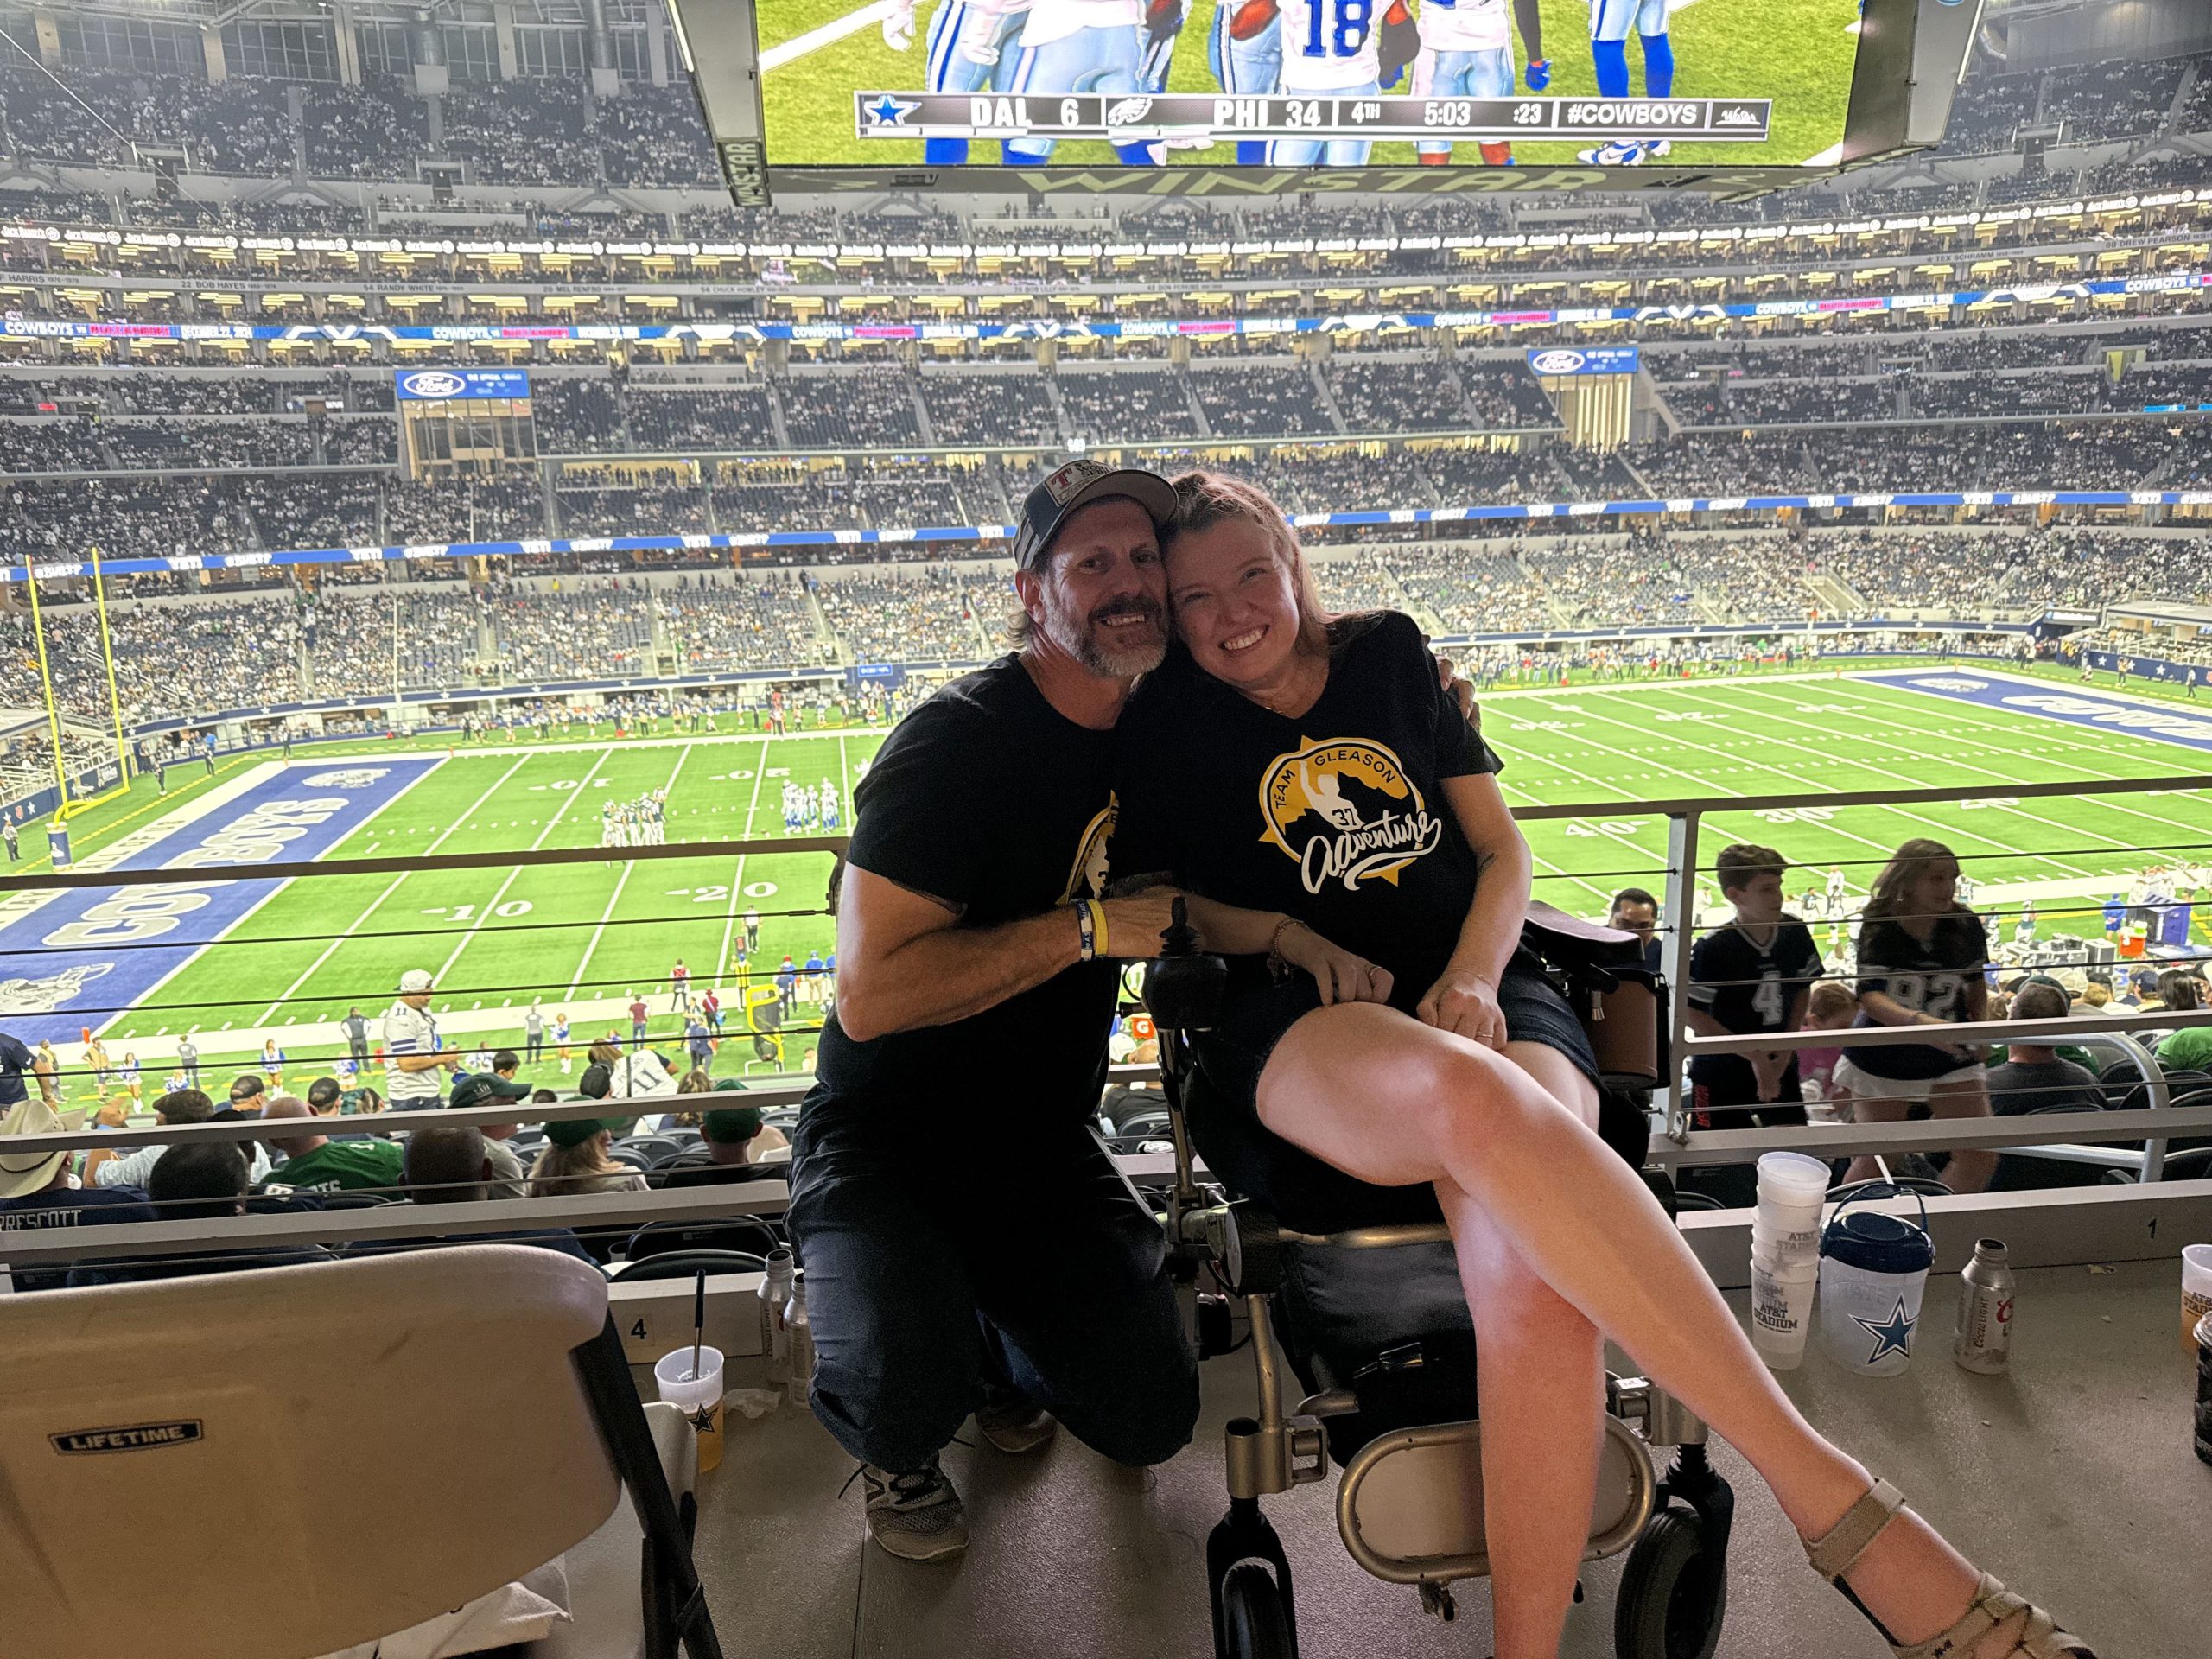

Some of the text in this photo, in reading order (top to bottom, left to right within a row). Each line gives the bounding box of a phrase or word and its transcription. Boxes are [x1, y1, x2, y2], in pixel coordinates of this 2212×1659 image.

[1302, 0, 1372, 57] 18
[970, 97, 1079, 127] DAL 6
[1214, 99, 1321, 129] PHI 34
[1351, 103, 1381, 124] 4TH
[1424, 102, 1470, 126] 5:03
[1567, 103, 1698, 124] #COWBOYS
[725, 143, 765, 206] WINSTAR
[2120, 238, 2145, 247] DREW
[2147, 234, 2190, 245] PEARSON
[1954, 251, 1994, 261] SCHRAMM
[9, 275, 45, 283] HARRIS
[2126, 276, 2187, 292] COWBOYS
[5, 323, 74, 335] COWBOYS
[433, 327, 492, 339] COWBOYS
[416, 376, 454, 391] Ford
[1051, 467, 1073, 489] T
[1314, 750, 1396, 784] GLEASON
[1274, 769, 1296, 810] TEAM
[1332, 808, 1357, 827] 37
[1301, 809, 1441, 894] Adventure
[1752, 970, 1783, 1026] 4
[633, 1069, 664, 1092] 11
[2148, 1219, 2158, 1239] 1
[1753, 1307, 1798, 1329] STADIUM
[1759, 1303, 1788, 1319] AT&T
[1979, 1297, 1989, 1323] LIGHT
[631, 1319, 647, 1340] 4
[69, 1425, 185, 1451] LIFETIME
